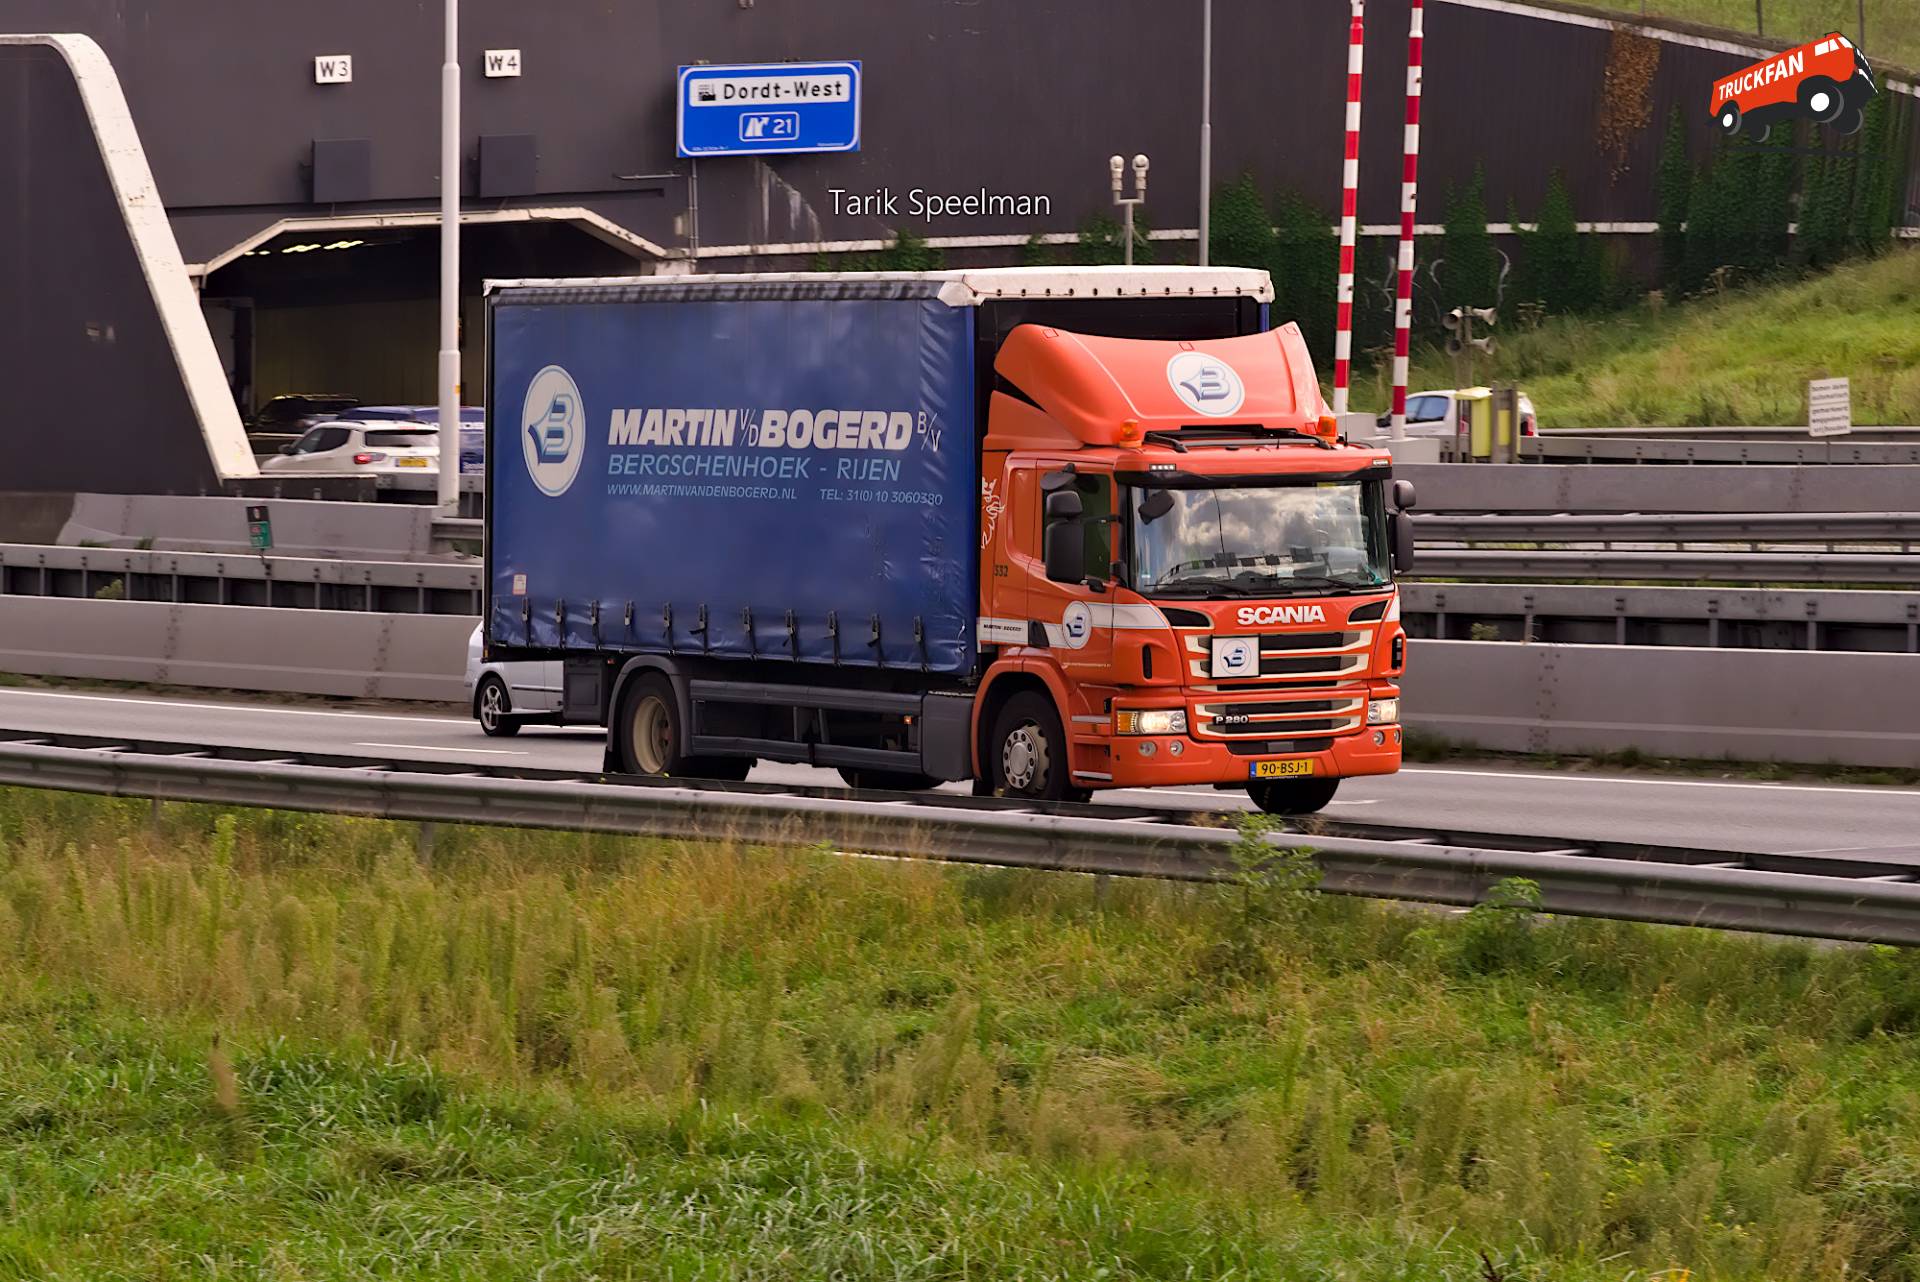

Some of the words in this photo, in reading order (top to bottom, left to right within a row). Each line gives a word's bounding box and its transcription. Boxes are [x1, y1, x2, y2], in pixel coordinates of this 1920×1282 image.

[320, 60, 349, 78] W3
[488, 55, 518, 71] W4
[723, 80, 843, 100] Dordt-West
[772, 118, 793, 135] 21
[607, 408, 738, 447] MARTIN
[758, 408, 914, 451] BOGERD
[607, 453, 812, 480] BERGSCHENHOEK
[836, 457, 901, 482] RIJEN
[606, 483, 798, 501] WWW.MARTINVANDENBOGERD.NL
[819, 487, 844, 501] TEL:
[1236, 604, 1327, 626] SCANIA
[1215, 716, 1224, 725] P
[1225, 714, 1249, 725] 280
[1261, 760, 1309, 776] 90-BSJ-1
